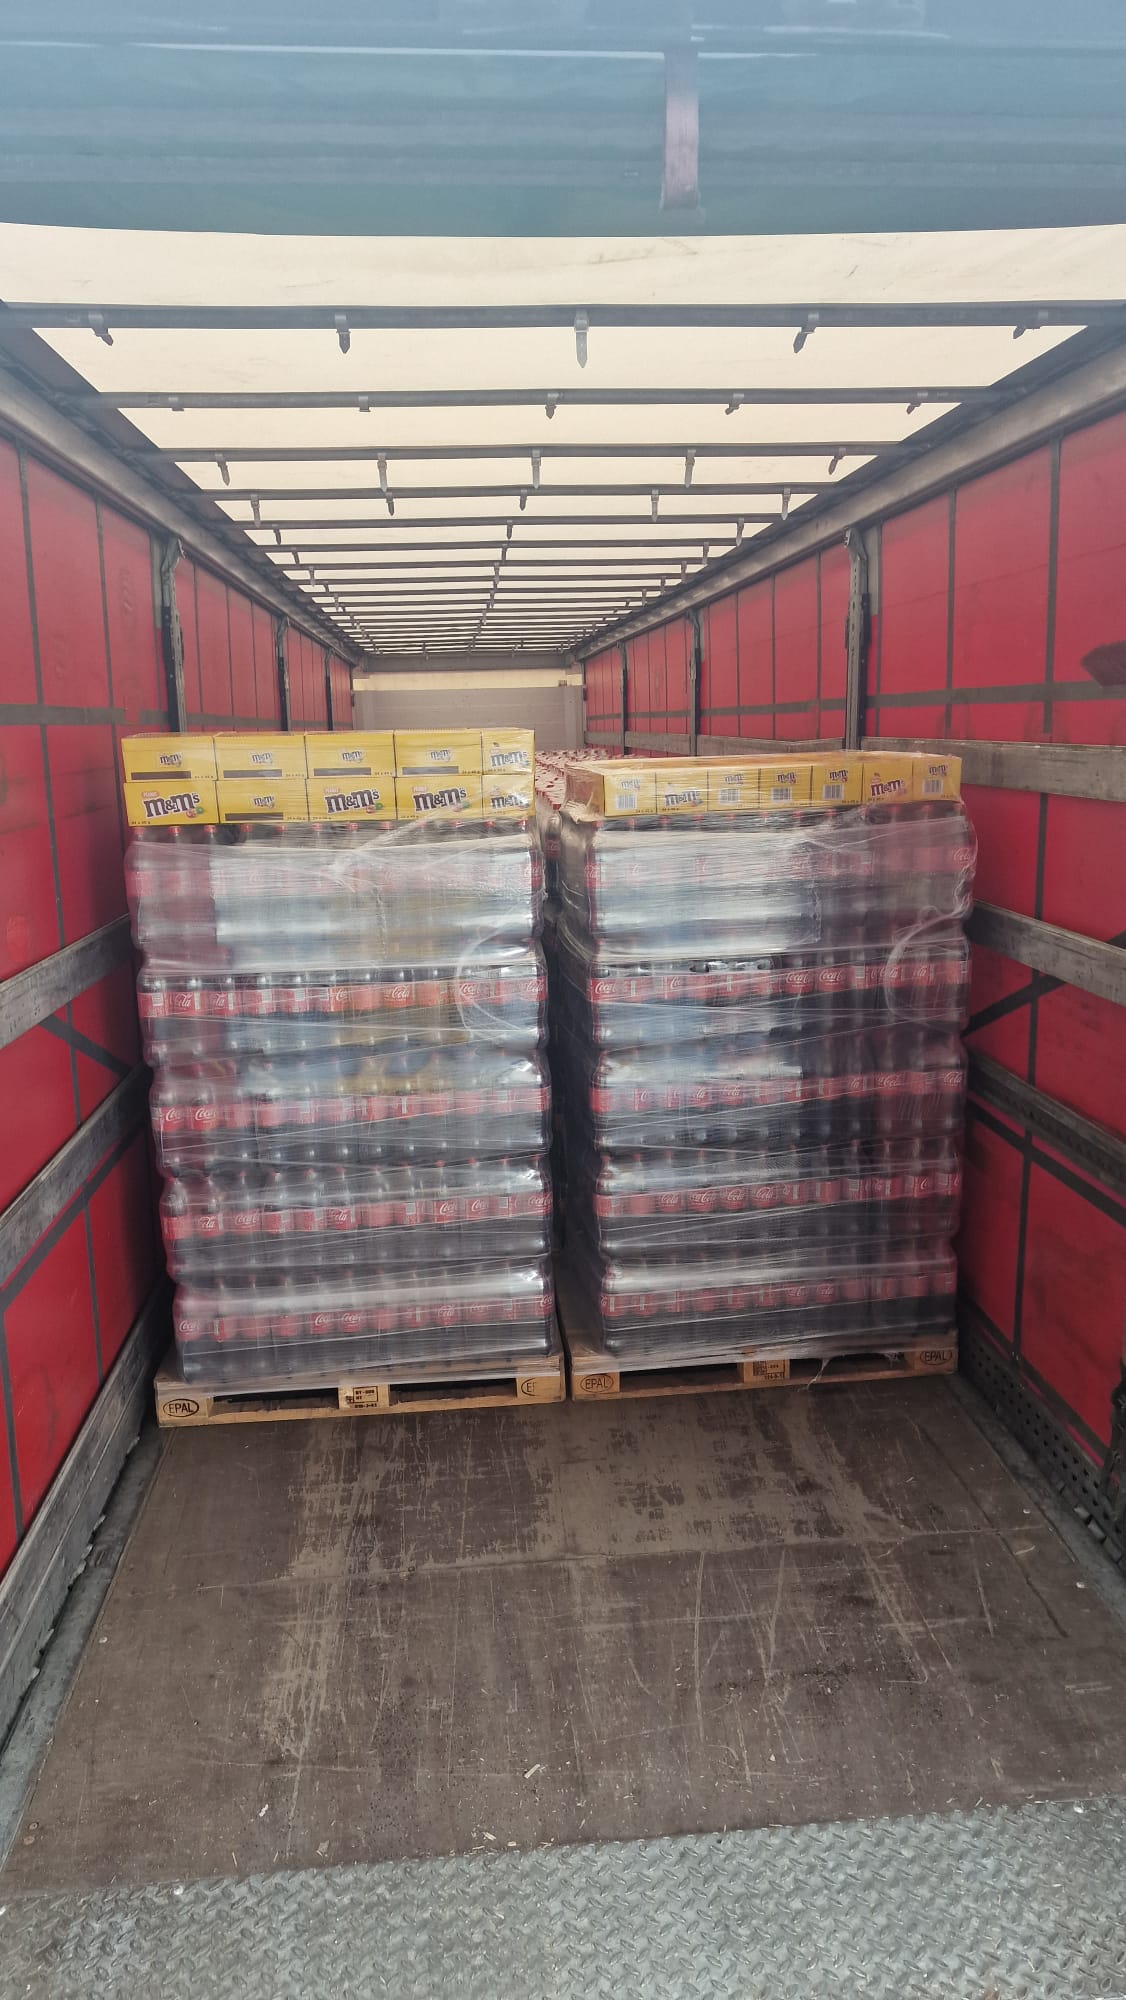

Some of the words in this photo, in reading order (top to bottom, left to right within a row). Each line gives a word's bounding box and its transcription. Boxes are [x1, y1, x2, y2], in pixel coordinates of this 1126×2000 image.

[144, 792, 200, 818] m&m's
[924, 1350, 947, 1362] EPAL
[585, 1376, 608, 1389] EPAL
[168, 1402, 194, 1414] EPAL
